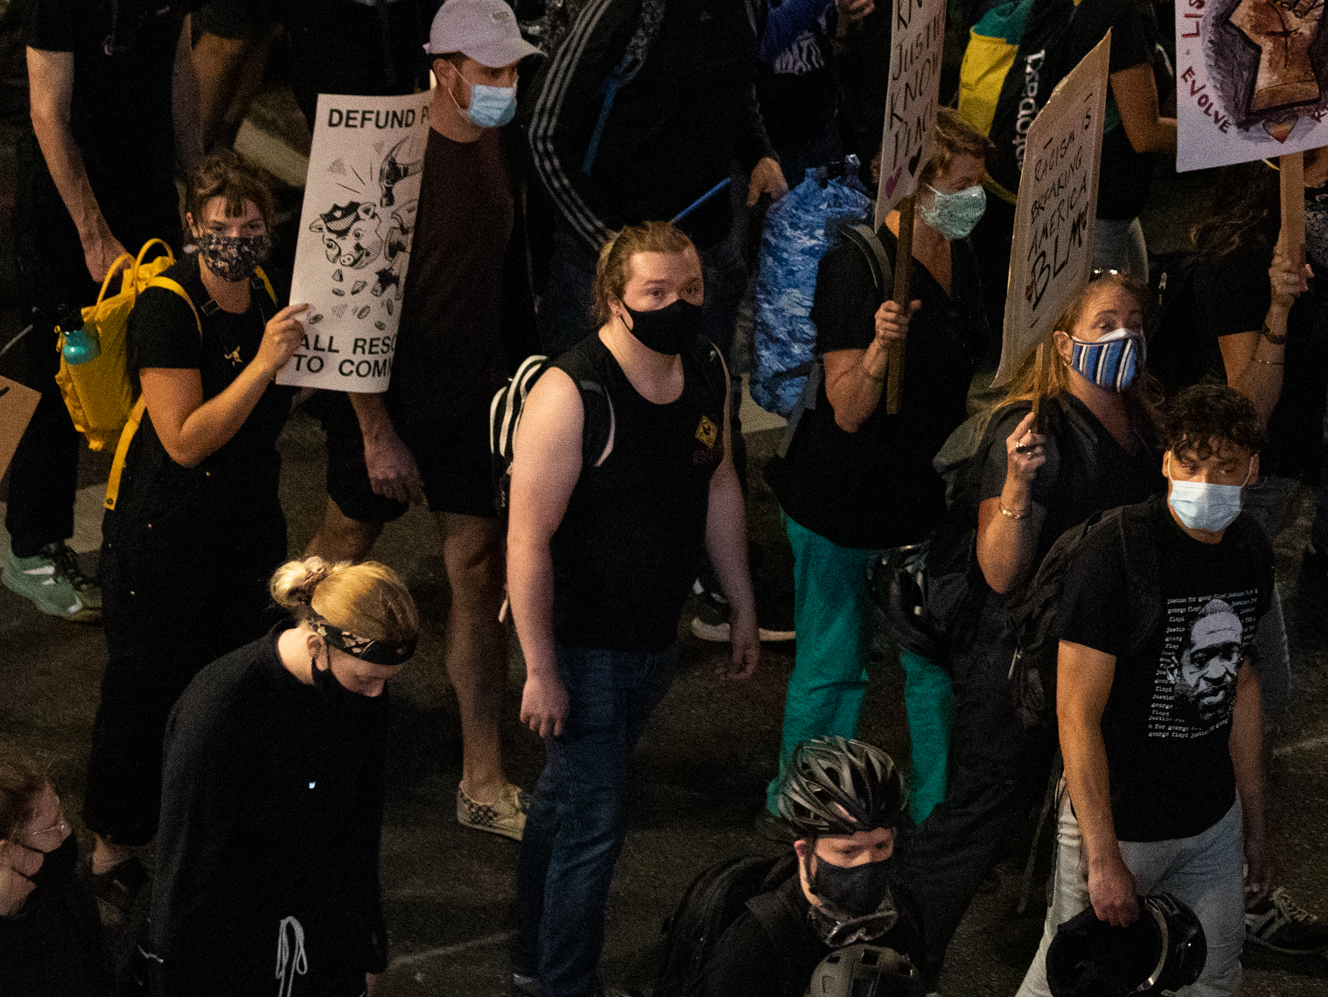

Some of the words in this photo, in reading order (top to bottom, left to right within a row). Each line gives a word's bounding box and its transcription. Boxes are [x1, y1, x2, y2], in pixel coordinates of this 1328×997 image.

[327, 108, 416, 130] DEFUND
[1180, 65, 1233, 134] EVOLVE
[1034, 130, 1075, 188] RACISM
[1081, 108, 1092, 135] IS
[1028, 172, 1087, 261] AMERICA
[1031, 146, 1083, 225] BREAKING
[1031, 215, 1083, 311] BLM
[293, 354, 324, 374] TO
[300, 335, 340, 354] ALL
